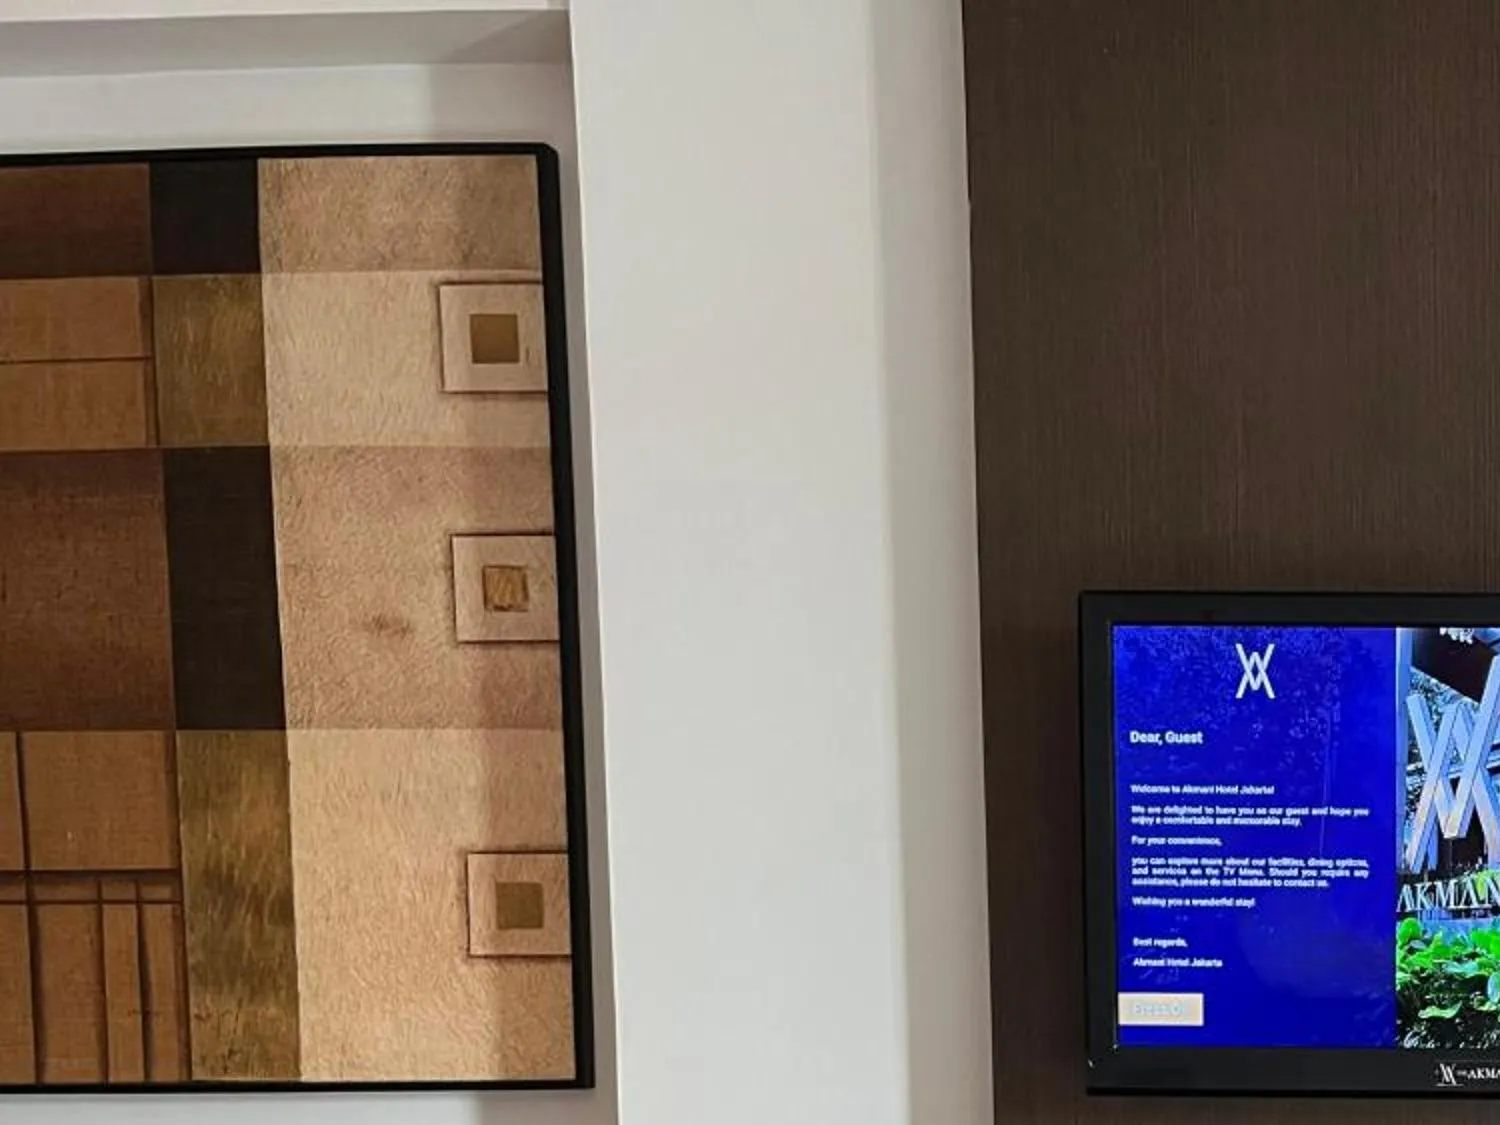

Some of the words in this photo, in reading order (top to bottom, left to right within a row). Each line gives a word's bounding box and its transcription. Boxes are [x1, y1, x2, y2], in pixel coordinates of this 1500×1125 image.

[1129, 731, 1163, 746] Dear,
[1165, 731, 1204, 744] Guest
[1131, 784, 1170, 795] Welcome
[1171, 784, 1181, 795] to
[1215, 784, 1239, 795] Hotel
[1131, 805, 1145, 816] We
[1147, 805, 1162, 816] are
[1163, 805, 1203, 816] delighted
[1203, 805, 1215, 816] to
[1215, 805, 1237, 816] have
[1237, 805, 1255, 816] you
[1268, 805, 1283, 816] our
[1285, 805, 1309, 816] guest
[1311, 805, 1328, 816] and
[1329, 805, 1352, 816] hope
[1353, 805, 1370, 816] you
[1131, 816, 1155, 827] enjoy
[1163, 816, 1214, 827] comfortable
[1215, 816, 1232, 827] and
[1233, 816, 1281, 827] memorable
[1131, 836, 1147, 846] For
[1147, 836, 1166, 846] your
[1131, 857, 1148, 867] you
[1149, 857, 1166, 867] can
[1167, 857, 1199, 867] explore
[1200, 857, 1223, 867] more
[1225, 857, 1250, 867] about
[1251, 857, 1266, 867] our
[1307, 857, 1333, 867] dining
[1131, 866, 1149, 878] and
[1151, 866, 1187, 878] services
[1205, 866, 1220, 878] the
[1223, 866, 1237, 878] TV
[1269, 866, 1299, 878] Should
[1301, 866, 1318, 878] you
[1320, 866, 1351, 878] require
[1353, 866, 1369, 878] any
[1179, 877, 1209, 888] please
[1209, 877, 1221, 888] do
[1221, 877, 1237, 888] not
[1237, 877, 1272, 888] hesitate
[1273, 877, 1283, 888] to
[1284, 877, 1315, 888] contact
[1131, 896, 1167, 908] Wishing
[1167, 896, 1183, 908] you
[1192, 896, 1235, 908] wonderful
[1132, 937, 1153, 948] Best
[1166, 957, 1190, 968] Hotel
[1191, 957, 1223, 968] Jakarta
